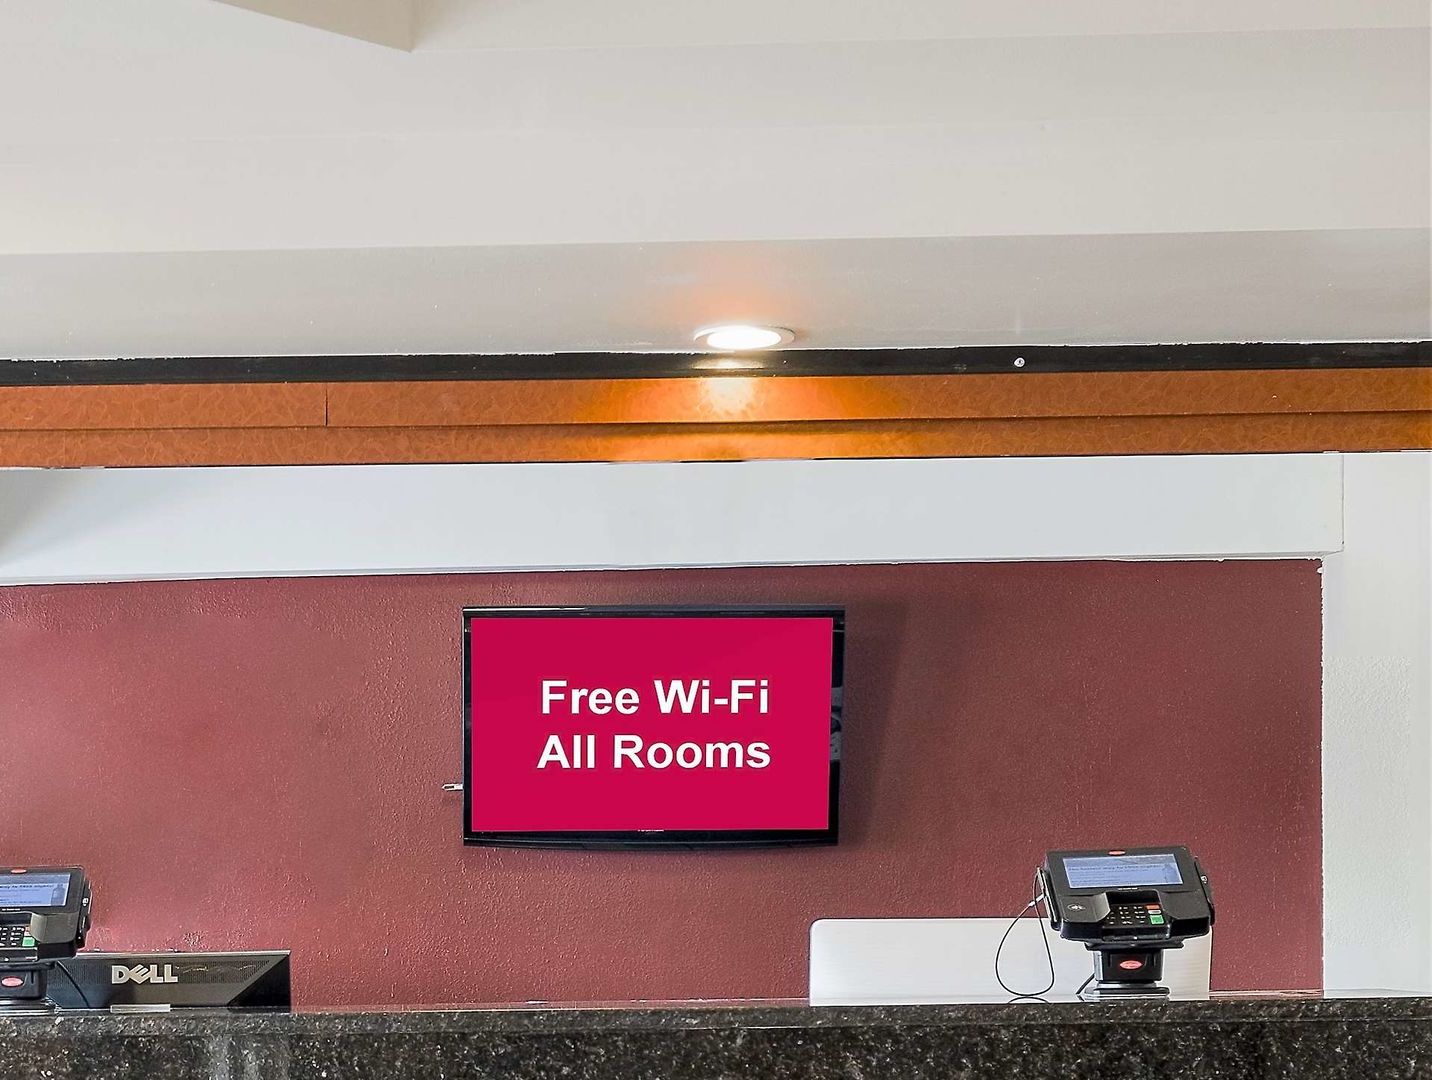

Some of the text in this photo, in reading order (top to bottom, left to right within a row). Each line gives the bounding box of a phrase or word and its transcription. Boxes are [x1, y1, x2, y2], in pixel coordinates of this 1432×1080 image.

[542, 679, 769, 714] Free Wi-Fi
[536, 734, 771, 769] All Rooms
[111, 964, 179, 984] DELL
